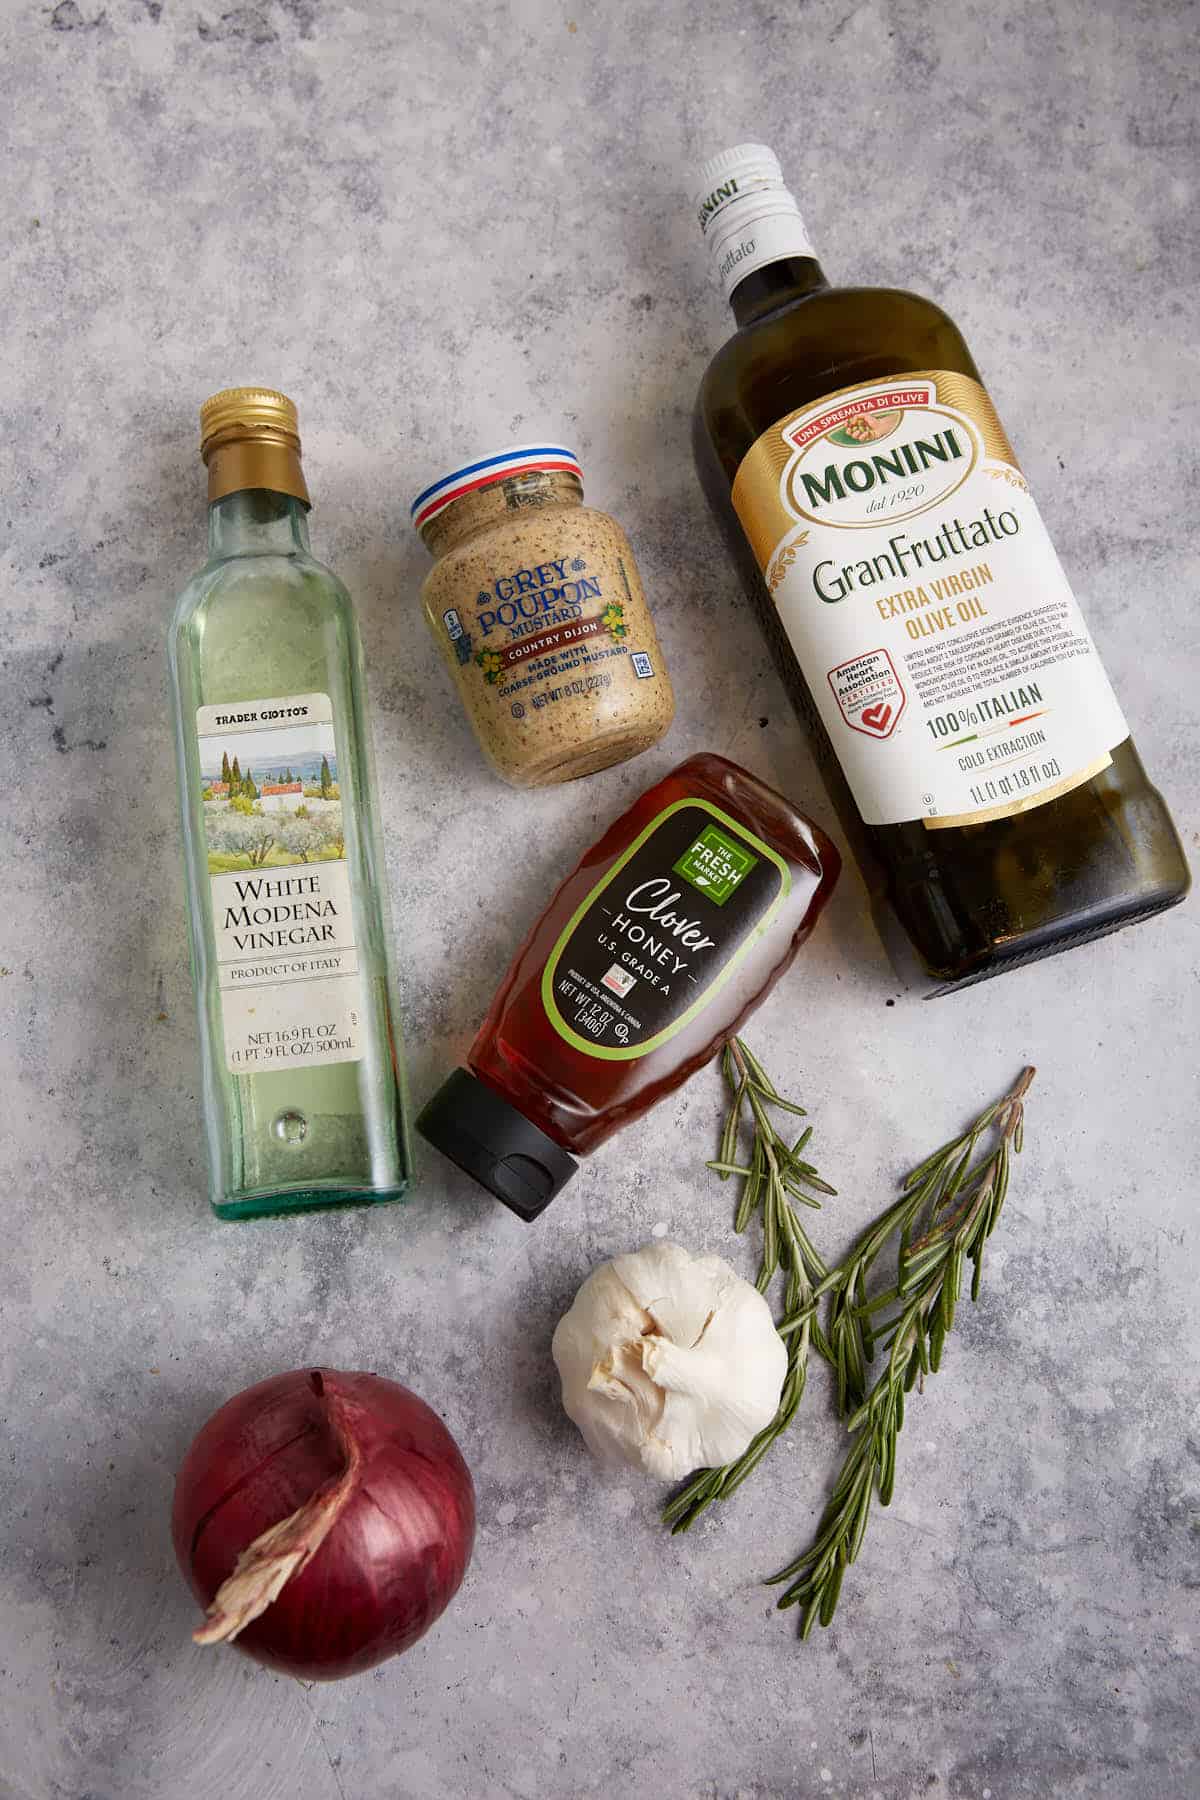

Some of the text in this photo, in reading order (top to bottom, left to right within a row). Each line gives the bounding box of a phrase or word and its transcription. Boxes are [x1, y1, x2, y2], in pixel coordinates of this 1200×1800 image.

[797, 393, 924, 442] UNA SPREMUTA DI OLIVE
[801, 429, 963, 508] MONINI
[866, 484, 925, 514] dal 1920
[812, 508, 1020, 604] GranFruttato
[495, 558, 568, 601] GREY
[875, 563, 994, 620] EXTRA VIRGIN
[478, 576, 602, 637] POUPON
[510, 605, 582, 639] MUSTARD
[905, 596, 988, 641] OLIVE OIL
[509, 623, 598, 660] COUNTRY DIJON
[582, 646, 628, 665] MUSTARD
[528, 644, 588, 672] MADE WITH
[836, 654, 880, 679] American
[838, 668, 891, 697] Association
[847, 666, 874, 684] Heart
[532, 693, 549, 709] NET
[548, 687, 564, 702] WT
[571, 680, 586, 694] OZ
[840, 678, 895, 706] CERTIFIED
[215, 712, 258, 725] TRADER
[926, 682, 1043, 739] 100% ITALIAN
[958, 730, 1046, 771] COLD EXTRACTION
[999, 776, 1013, 796] qt
[1013, 769, 1030, 789] 1.8
[1030, 765, 1041, 783] fl
[691, 842, 742, 885] FRESH
[717, 847, 734, 861] THE
[693, 860, 724, 885] MARKET
[233, 875, 321, 904] WHITE
[223, 898, 339, 930] MODENA
[626, 878, 716, 953] Clover
[232, 923, 337, 952] VINEGAR
[611, 913, 688, 975] HONEY
[231, 958, 342, 979] PRODUCT OF ITALY
[597, 934, 617, 955] U.S.
[621, 952, 661, 986] GRADE
[660, 985, 671, 996] A
[559, 979, 615, 1027] NET WT 12 OZ
[231, 1036, 355, 1062] (1 PT .9 FL OZ) 500mL
[248, 1024, 337, 1046] NET 16.9 FL OZ
